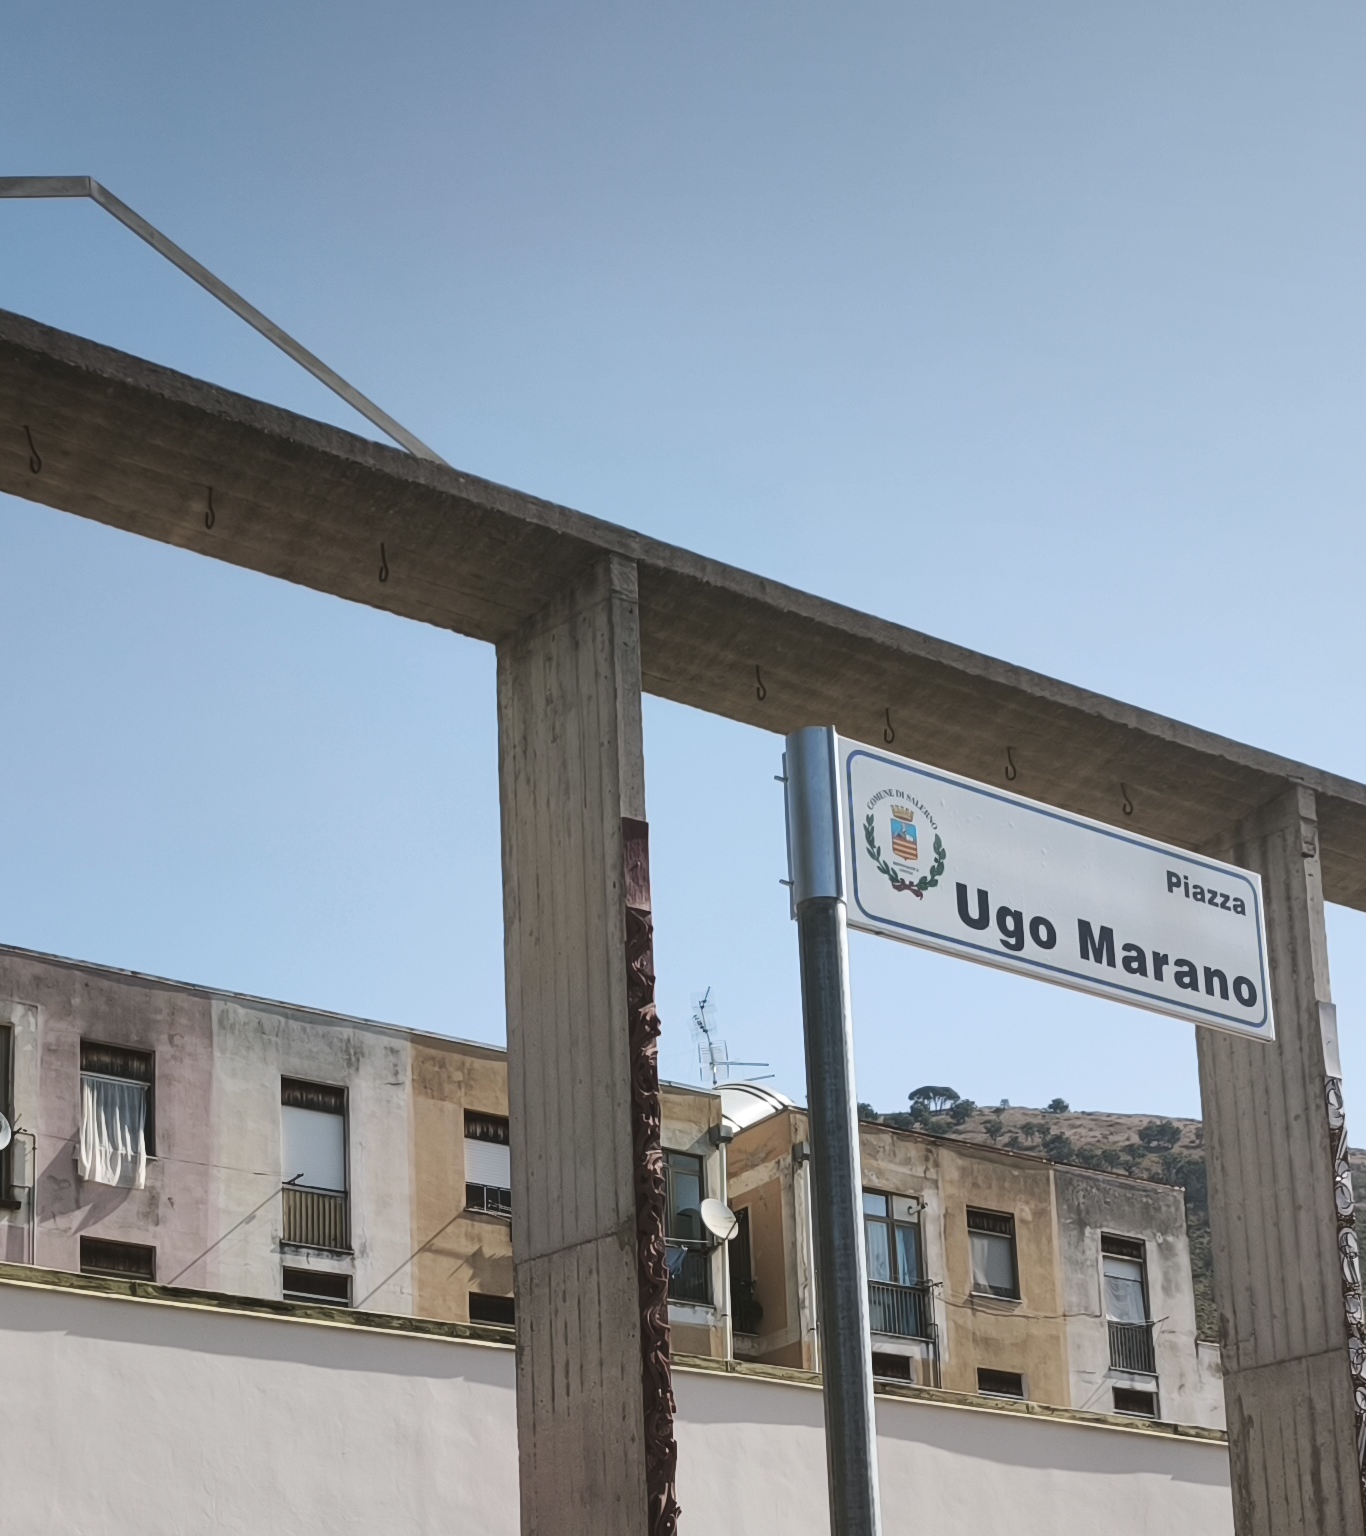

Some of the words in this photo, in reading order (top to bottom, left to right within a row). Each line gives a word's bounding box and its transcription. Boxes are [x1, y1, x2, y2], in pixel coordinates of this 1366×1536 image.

[866, 788, 895, 811] COMUNE
[895, 789, 905, 799] DI
[905, 793, 939, 831] SALERNO
[1165, 869, 1247, 917] Piazza
[955, 881, 1057, 952] Ugo
[1077, 917, 1258, 1008] Marano
